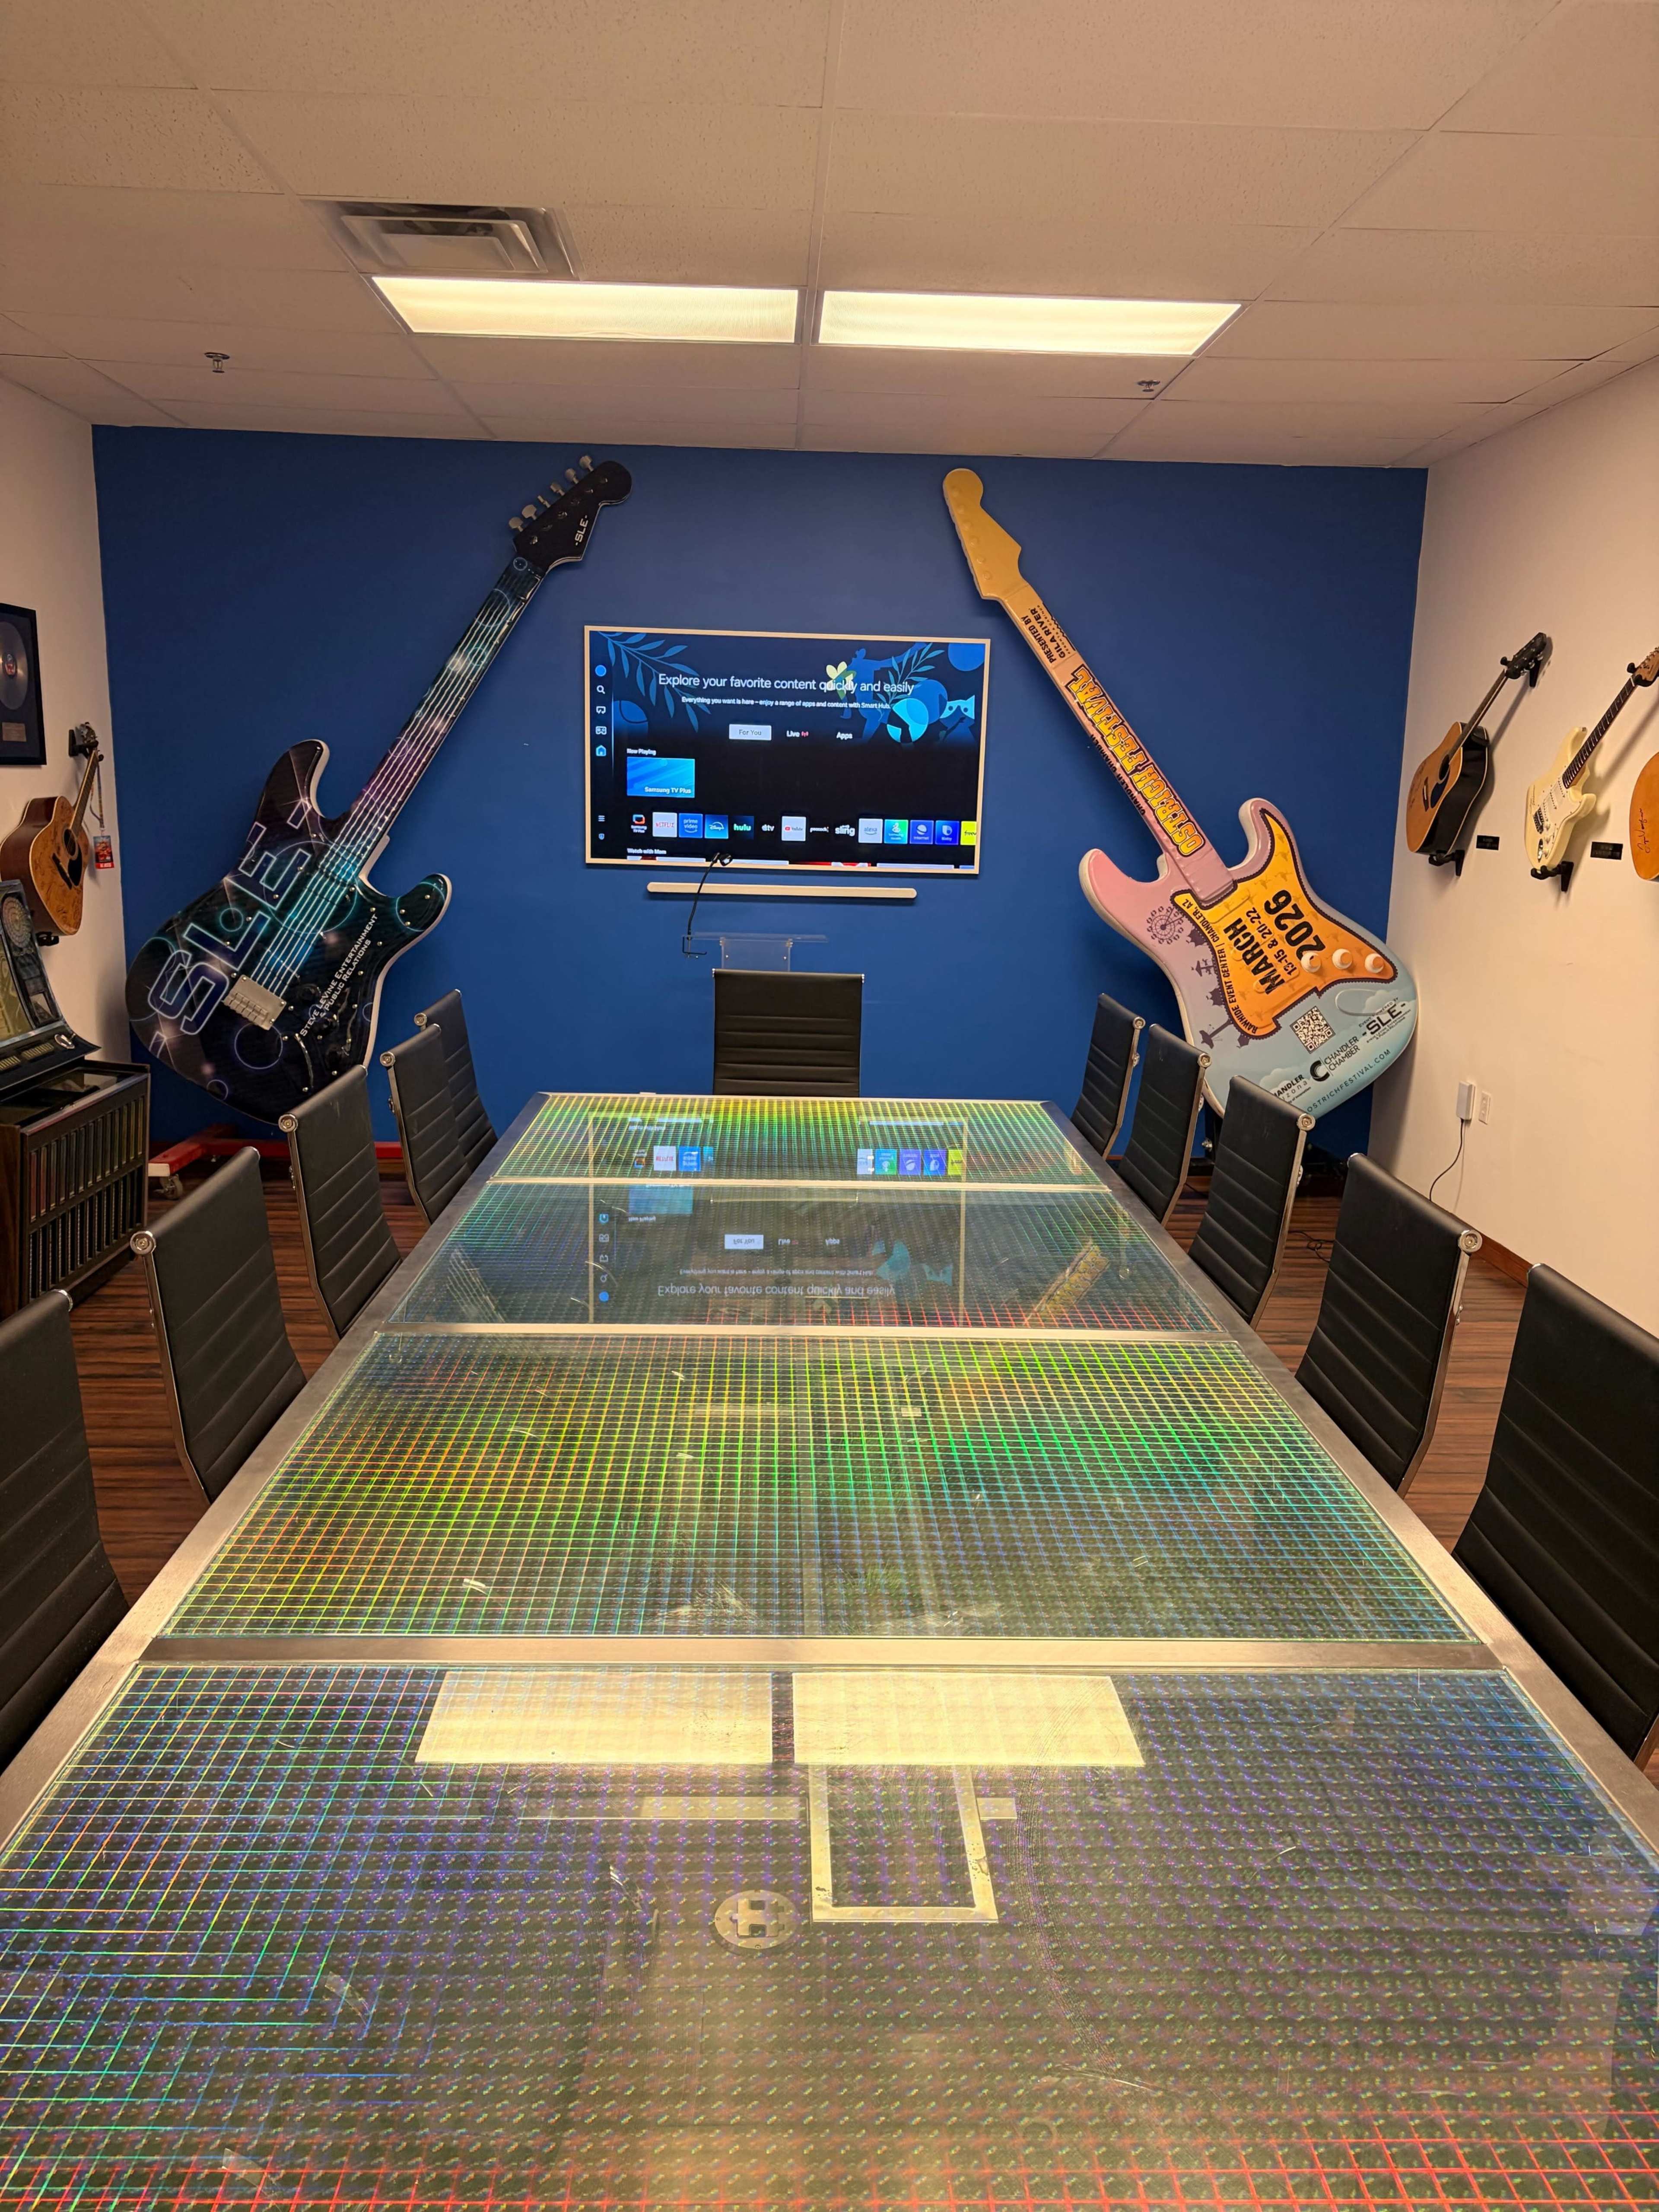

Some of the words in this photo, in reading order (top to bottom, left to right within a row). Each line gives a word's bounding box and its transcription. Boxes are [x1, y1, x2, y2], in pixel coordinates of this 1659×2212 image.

[1021, 615, 1031, 625] BY
[1030, 608, 1052, 636] RIVER
[1029, 625, 1056, 663] PRESENTED
[1050, 636, 1065, 658] GILA
[659, 674, 700, 687] Explore
[702, 678, 728, 689] your
[730, 676, 772, 688] favorite
[774, 679, 817, 690] content
[819, 680, 858, 694] quickly
[860, 680, 880, 692] and
[883, 681, 915, 696] easily
[682, 696, 710, 705] Everything
[1067, 667, 1147, 773] FESTIVAL
[836, 732, 852, 740] Apps
[1131, 764, 1204, 857] OSTRICH
[835, 824, 855, 837] sling
[1182, 899, 1192, 909] AZ
[1192, 906, 1219, 942] CHANDLER,
[1246, 907, 1272, 939] 20-22
[1264, 890, 1326, 961] 2026
[1223, 918, 1285, 995] MARCH
[1268, 939, 1278, 949] &
[300, 1009, 320, 1036] STEVE
[317, 980, 337, 1009] LEVINE
[334, 913, 378, 979] ENTERTAINMENT
[324, 982, 345, 1011] PUBLIC
[342, 939, 372, 981] RELATIONS
[1217, 947, 1230, 978] CENTER
[1274, 949, 1297, 975] 13-15
[1224, 980, 1236, 1003] EVENT
[1232, 1005, 1258, 1034] RAWHIDE
[1324, 1036, 1359, 1065] CHANDLER
[1328, 1045, 1360, 1071] CHAMBER
[1274, 1074, 1304, 1097] ANDLER
[1307, 1049, 1391, 1113] OSTRICHFESTIVAL.COM
